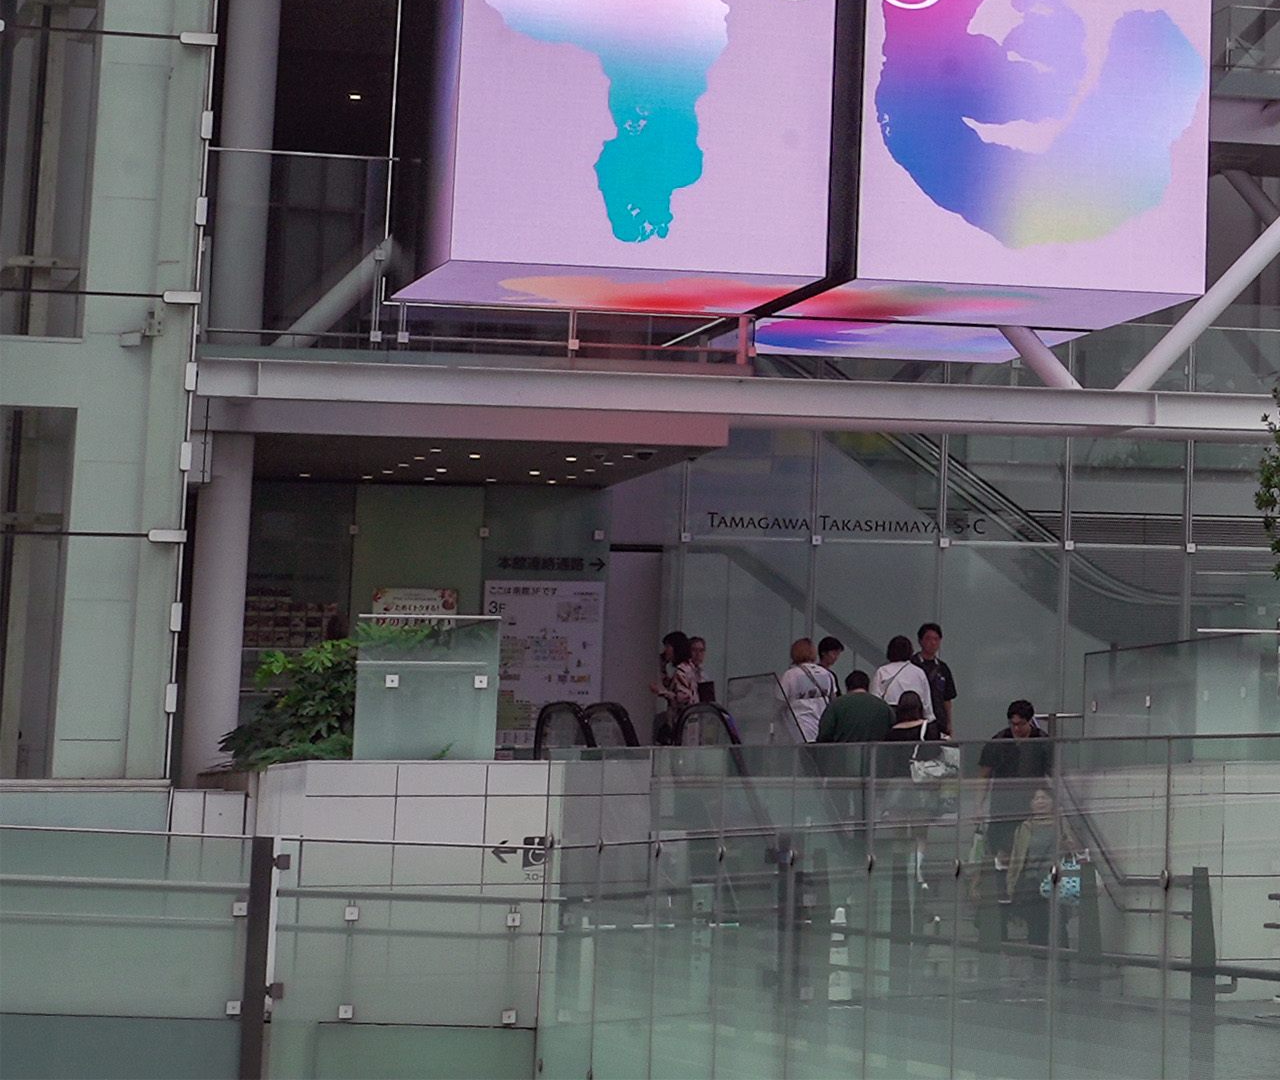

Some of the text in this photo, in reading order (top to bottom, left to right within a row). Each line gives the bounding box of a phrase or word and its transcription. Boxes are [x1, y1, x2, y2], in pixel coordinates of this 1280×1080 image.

[707, 511, 811, 531] TAMAGAWA
[819, 515, 942, 534] TAKASHIMAYA
[488, 600, 506, 614] 3F
